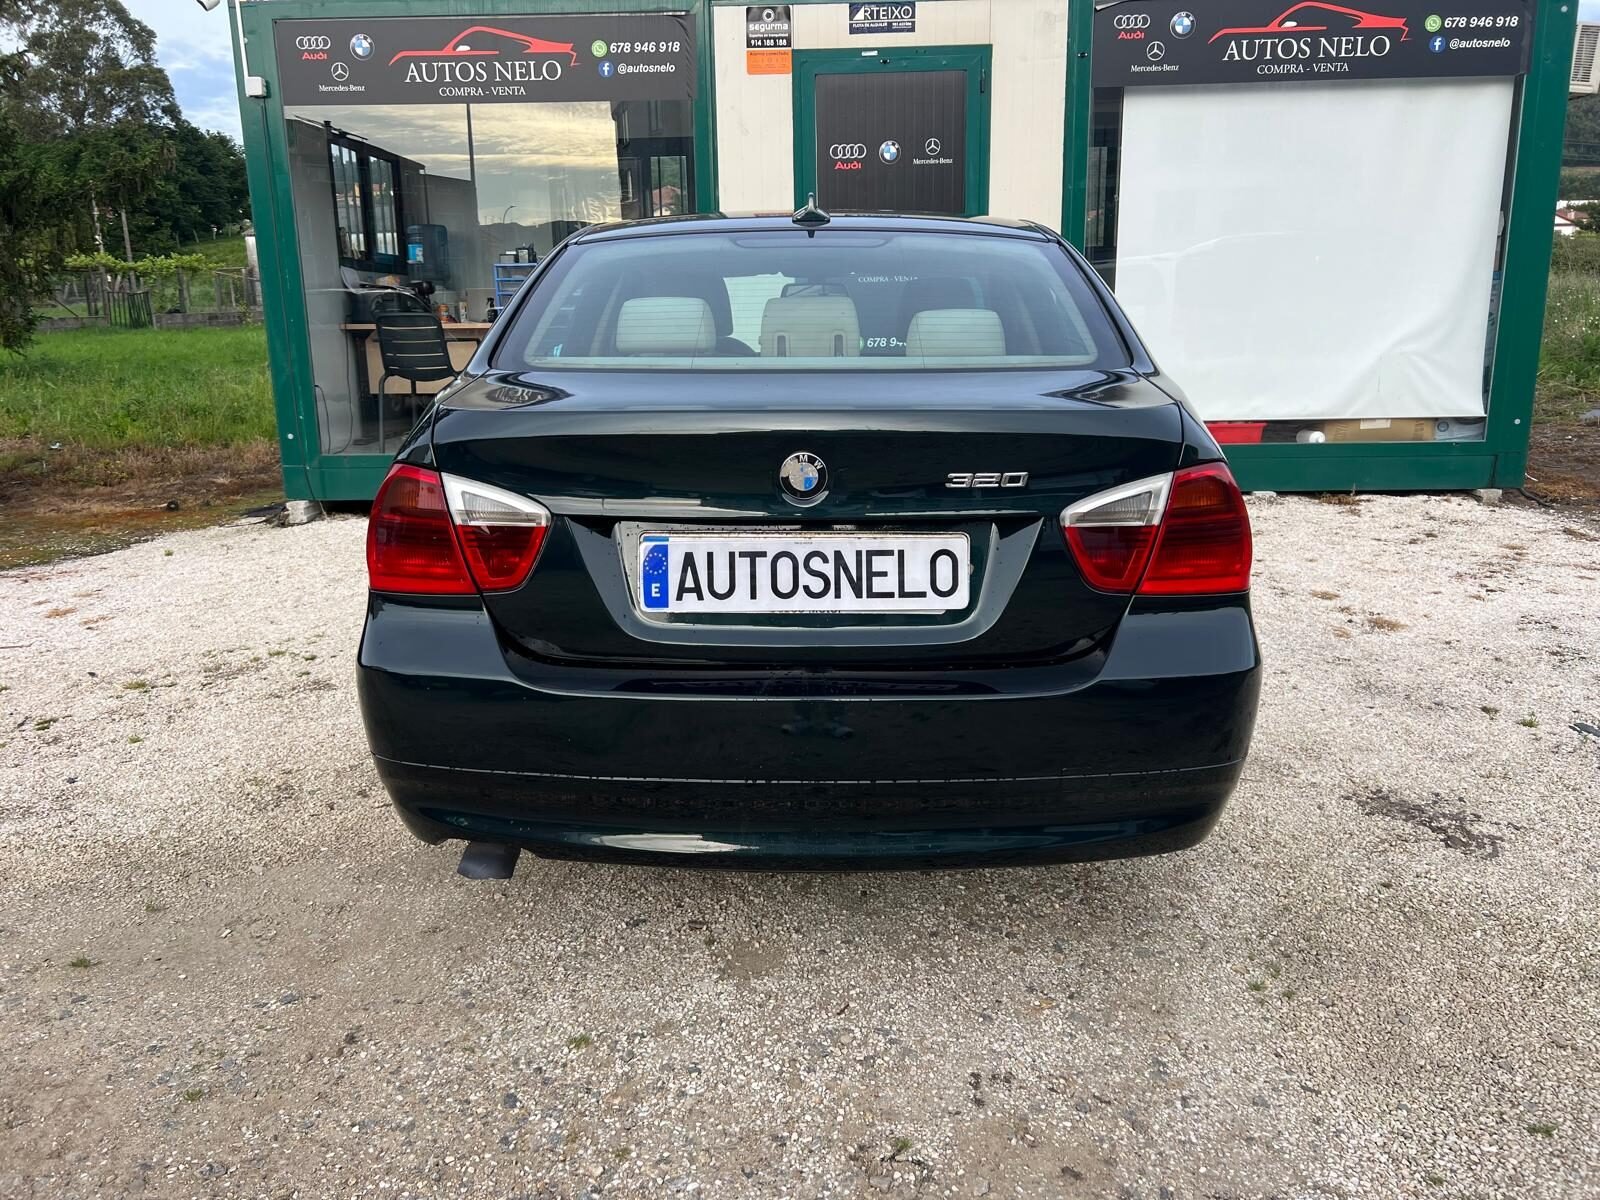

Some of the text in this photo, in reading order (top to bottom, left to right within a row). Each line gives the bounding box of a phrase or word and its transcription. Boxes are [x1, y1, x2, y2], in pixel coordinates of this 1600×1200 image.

[749, 23, 788, 32] segurma
[1444, 16, 1519, 28] 678 946 918
[1118, 31, 1145, 39] Audi
[609, 41, 680, 53] 678 946 918
[1222, 35, 1391, 61] AUTOS NELO
[1449, 37, 1511, 50] @autosnelo
[302, 52, 328, 60] Audi
[404, 60, 562, 83] AUTOS NELO
[617, 62, 676, 74] @autosnelo
[1130, 64, 1180, 72] Mercedes-Benz
[1257, 64, 1304, 75] COMPRA
[1313, 62, 1350, 73] VENTA
[319, 84, 366, 92] Mercedes-Benz
[438, 87, 484, 97] COMPRA
[491, 86, 527, 96] VENTA
[834, 161, 862, 170] Audi
[866, 337, 887, 348] 678
[945, 472, 1029, 488] 320
[675, 548, 960, 602] AUTOSNELO
[651, 583, 661, 597] E
